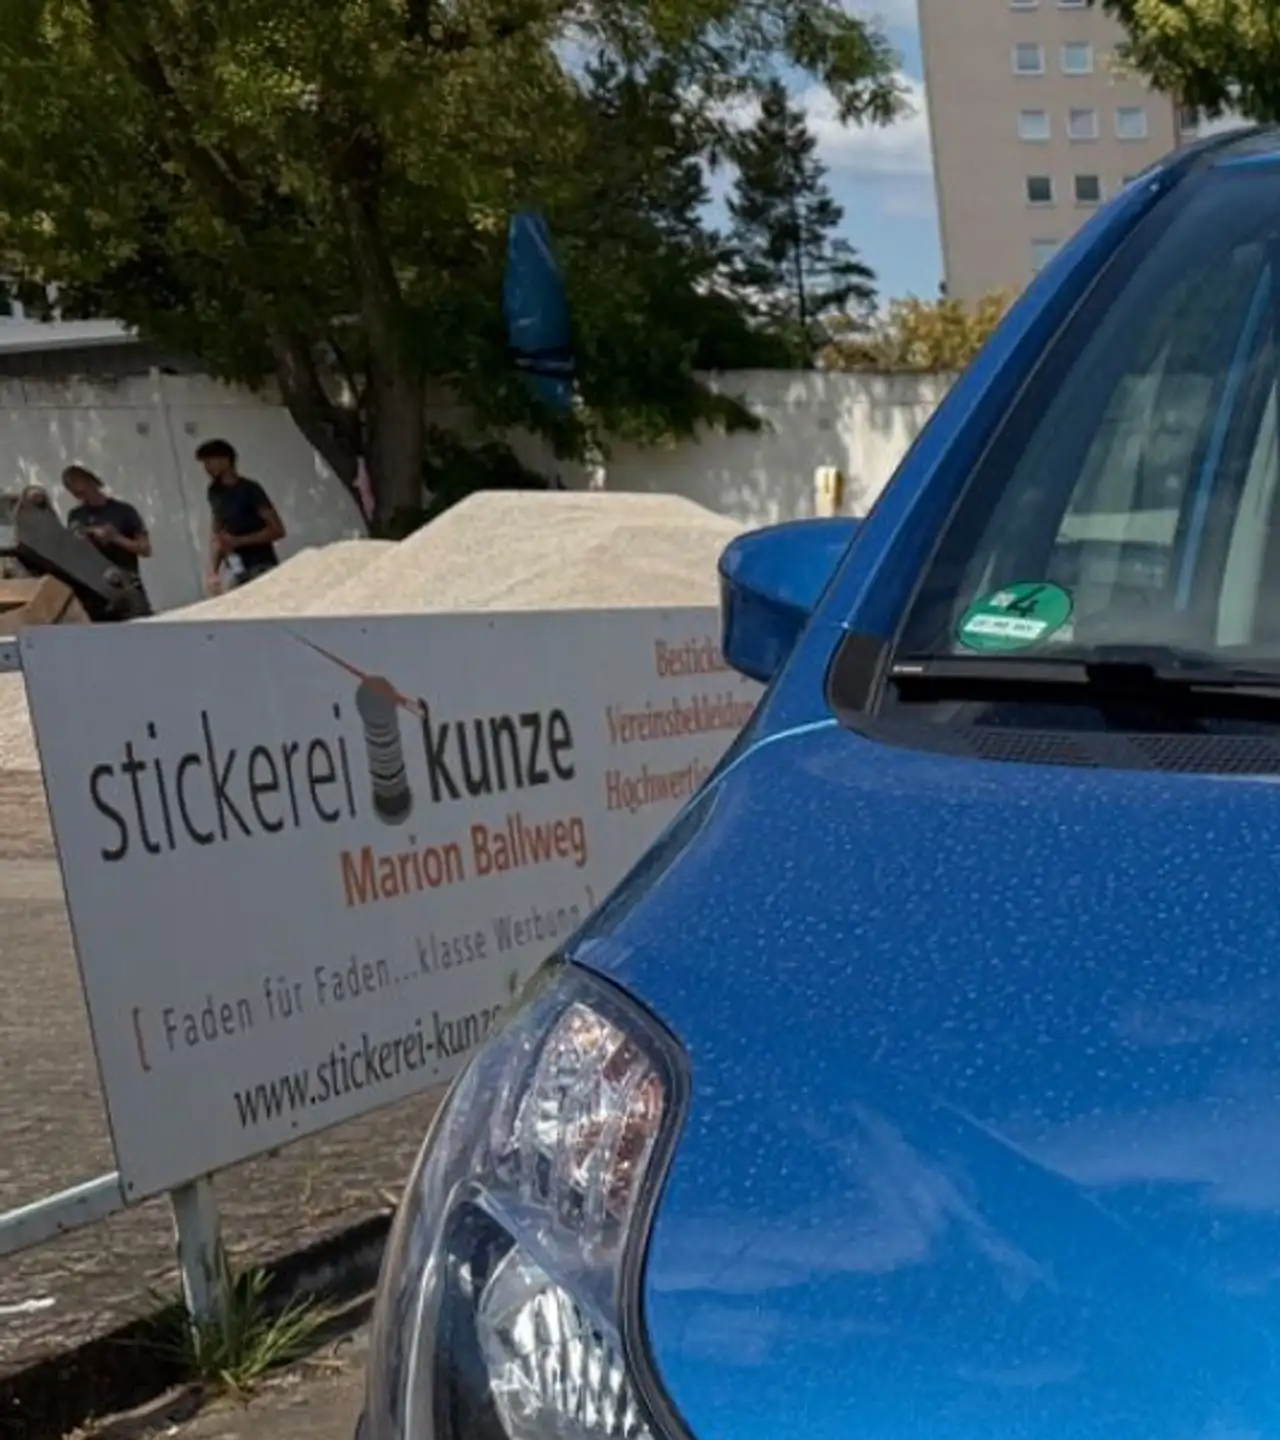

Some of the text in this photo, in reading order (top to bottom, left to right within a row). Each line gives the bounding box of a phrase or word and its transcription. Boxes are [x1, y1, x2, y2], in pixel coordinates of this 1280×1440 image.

[89, 697, 575, 862] stickerei kunze
[339, 811, 588, 907] Marion Ballweg
[161, 994, 254, 1052] Faden
[262, 975, 304, 1020] für
